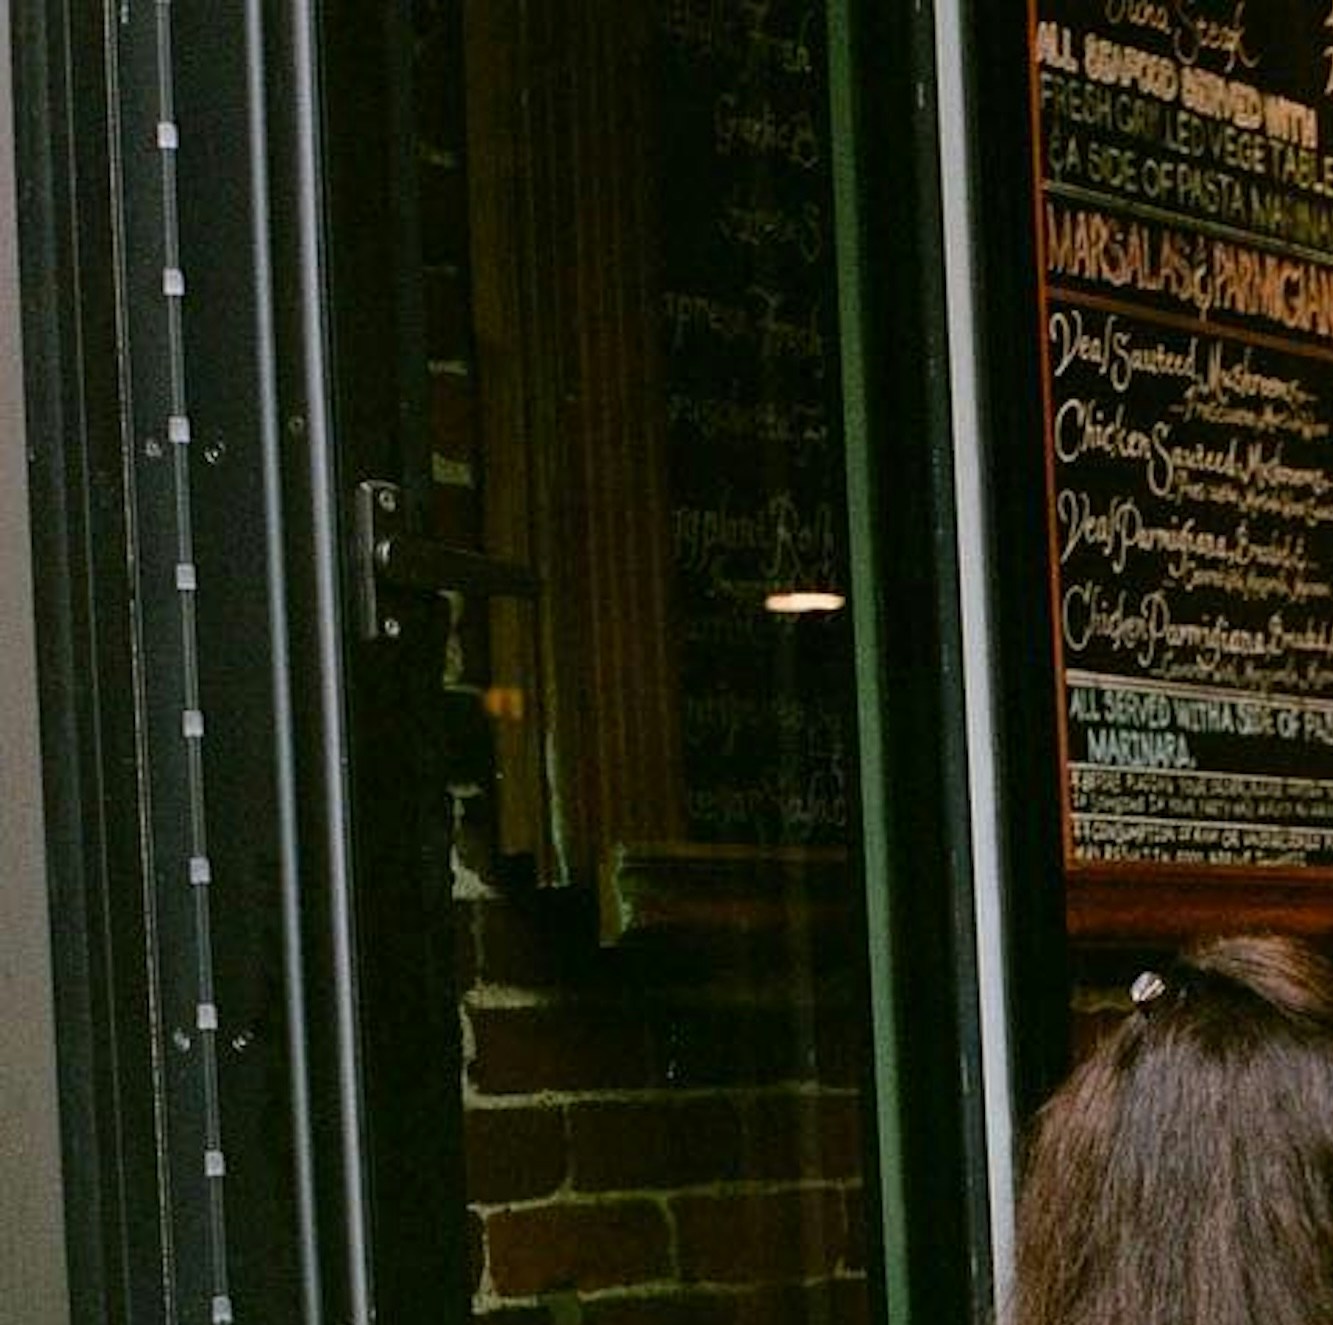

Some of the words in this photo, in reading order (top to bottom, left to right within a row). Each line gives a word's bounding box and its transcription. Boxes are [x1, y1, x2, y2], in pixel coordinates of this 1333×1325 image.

[1041, 71, 1115, 131] FRESH
[1069, 687, 1102, 724] ALL
[1103, 689, 1172, 730] SERVED
[1276, 709, 1302, 740] OF
